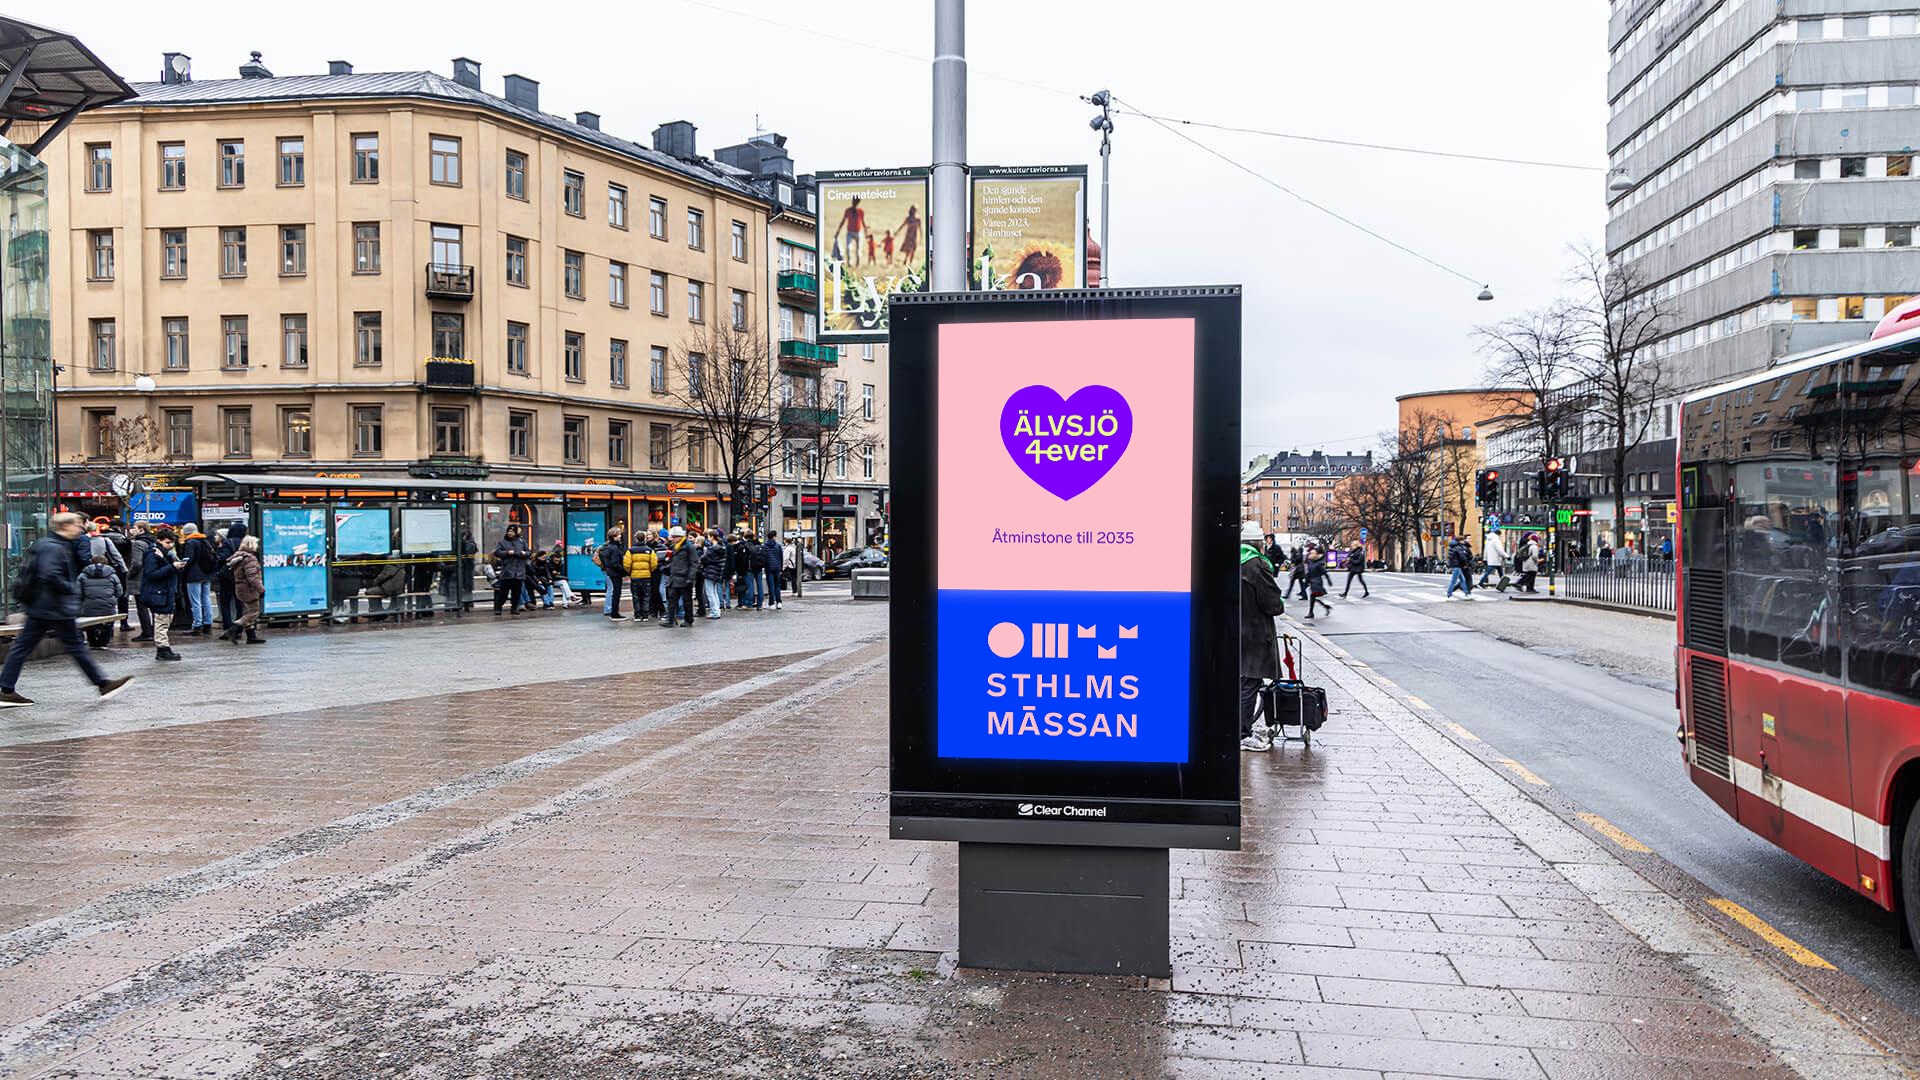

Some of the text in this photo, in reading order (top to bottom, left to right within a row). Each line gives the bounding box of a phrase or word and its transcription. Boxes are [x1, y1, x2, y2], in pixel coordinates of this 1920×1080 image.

[833, 169, 911, 178] www.kulturtavlorna.se
[988, 166, 1068, 174] www.kulturtavlorna.se
[983, 185, 1026, 196] Den sjunde
[983, 195, 1043, 205] himlen och den
[982, 205, 1041, 216] sjunde konsten
[982, 217, 1006, 228] Våren
[983, 228, 1022, 238] Filmhuset
[1013, 409, 1119, 437] ÄLVSJÖ
[1025, 439, 1109, 464] 4ever
[992, 528, 1135, 544] Åtminstone till 2035
[987, 672, 1139, 700] STHLMS
[1034, 805, 1107, 817] Clear Channel
